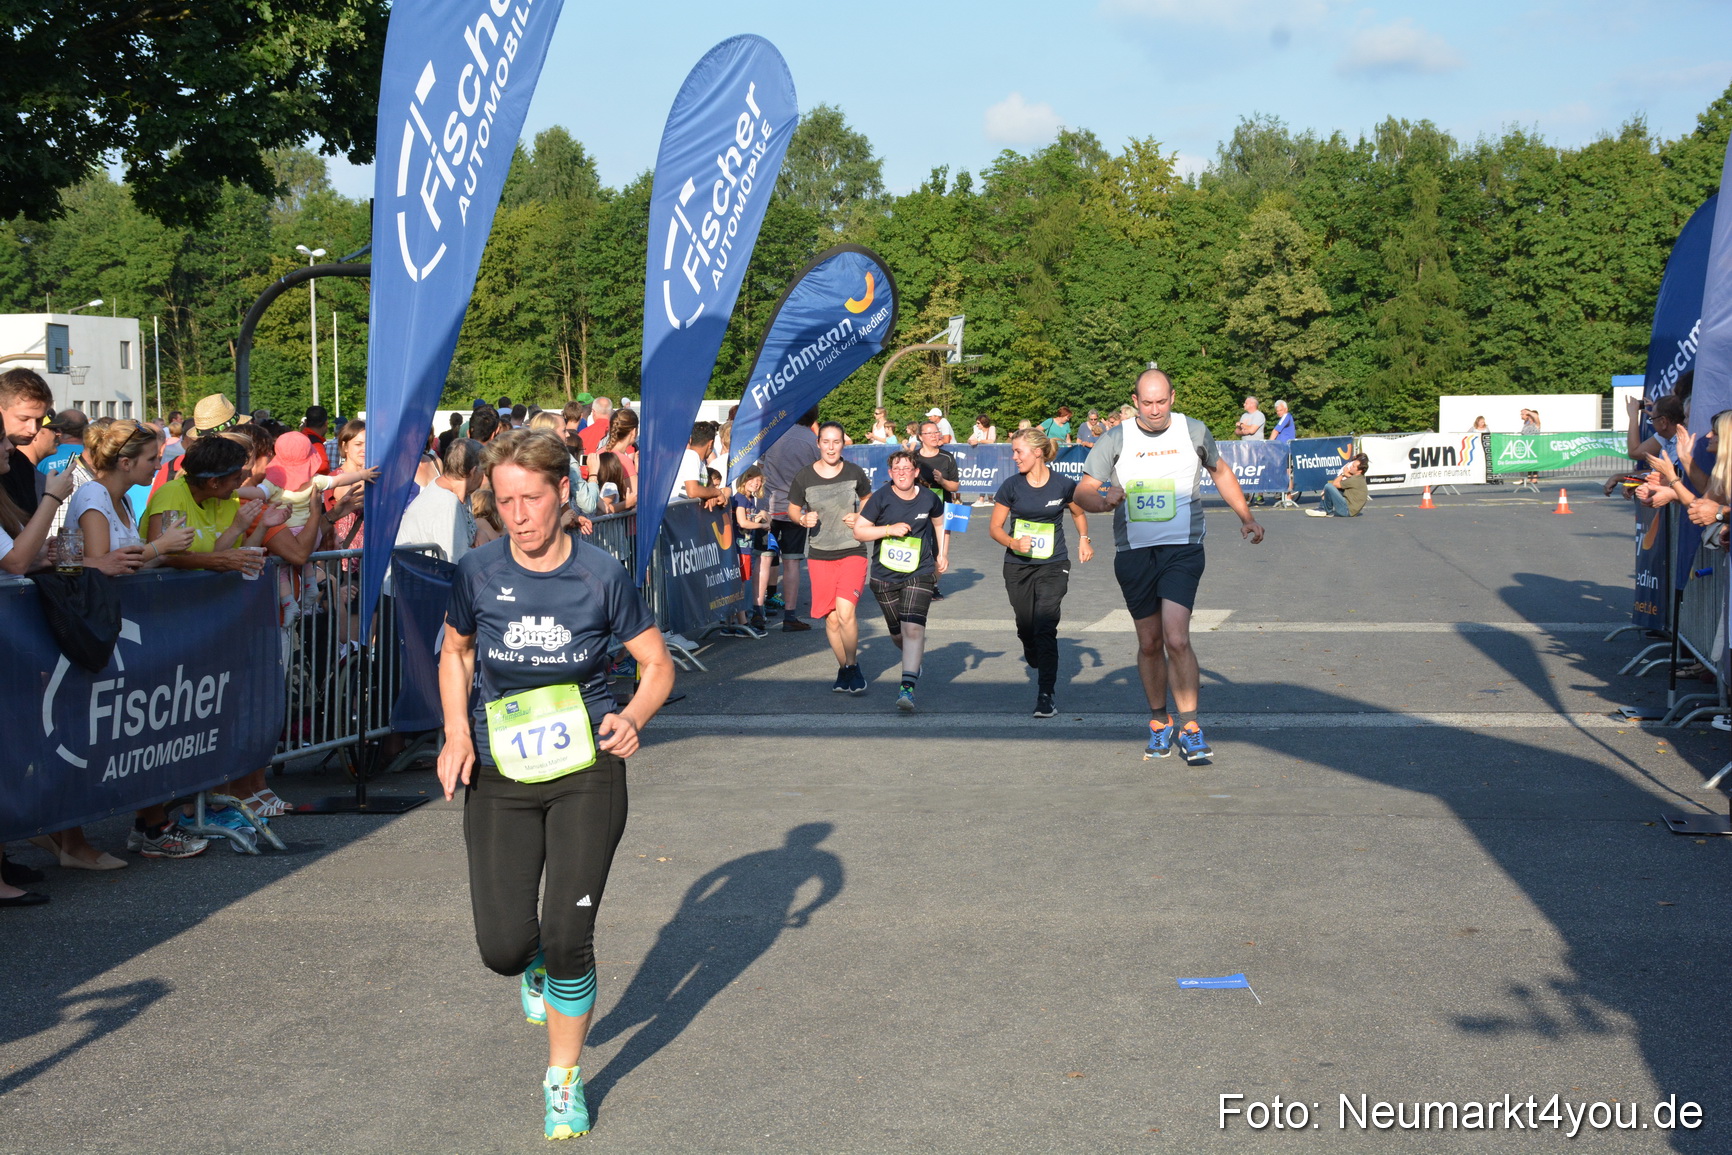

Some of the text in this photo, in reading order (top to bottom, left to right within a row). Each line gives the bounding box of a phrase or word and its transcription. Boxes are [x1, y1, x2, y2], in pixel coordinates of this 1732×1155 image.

[458, 0, 533, 227] AUTOMOBIL
[682, 81, 761, 295] Fischer
[711, 119, 772, 291] AUTOMOBILE
[816, 346, 841, 371] Druck
[858, 307, 889, 339] Medien
[751, 317, 853, 410] Frischmann
[1650, 318, 1702, 402] Frischm
[1296, 453, 1343, 470] Frischmann
[1408, 446, 1457, 470] swn
[1499, 440, 1538, 460] AOK
[957, 464, 999, 479] scher
[1136, 495, 1166, 510] 545
[670, 538, 721, 578] Frischmann
[888, 548, 913, 563] 692
[504, 621, 572, 652] Burgis
[488, 647, 589, 667] Weil's guad is!
[89, 664, 231, 746] Fischer
[101, 728, 220, 783] AUTOMOBILE
[511, 721, 571, 760] 173
